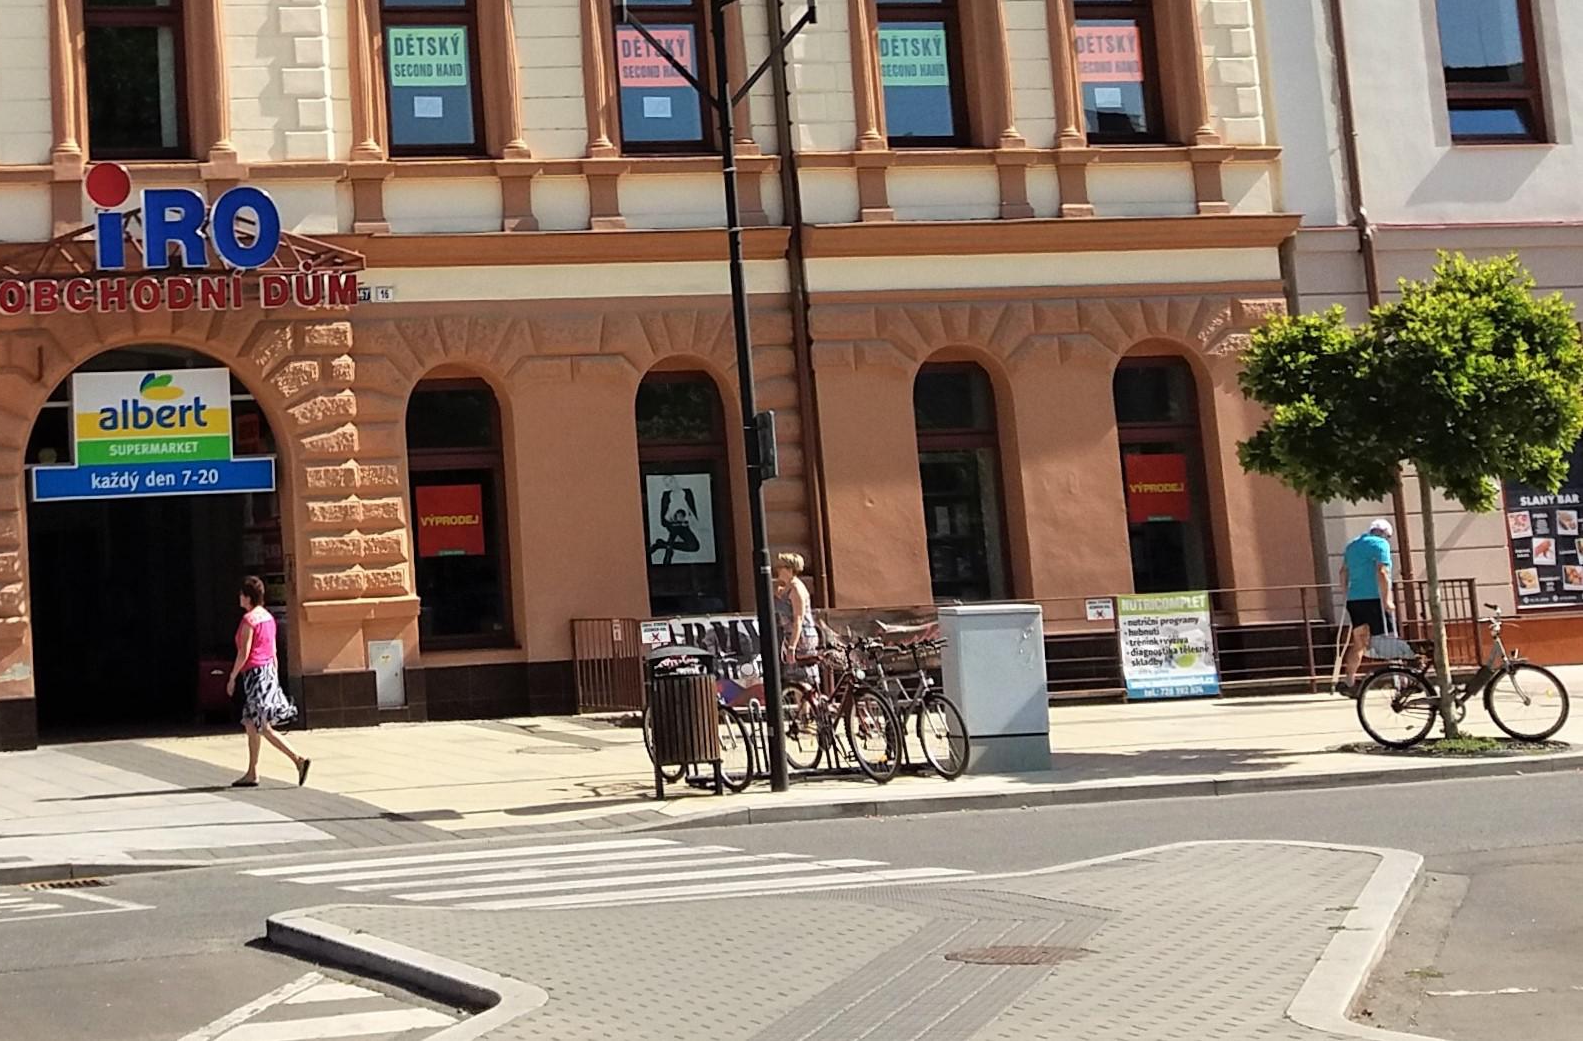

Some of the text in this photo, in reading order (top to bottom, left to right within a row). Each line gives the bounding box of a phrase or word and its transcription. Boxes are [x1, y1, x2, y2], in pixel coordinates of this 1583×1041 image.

[394, 33, 460, 56] DĚTSKÝ
[394, 63, 463, 77] SECOND HAND
[260, 261, 360, 309] DŮM
[99, 396, 208, 430] albert
[109, 441, 199, 456] SUPERMARKET
[91, 468, 219, 491] každý den 7-20
[1558, 494, 1580, 504] BAR
[420, 513, 479, 527] VÝPRODEJ
[1160, 616, 1199, 627] programy
[1130, 646, 1178, 657] diagnostika
[1131, 657, 1163, 667] skladby
